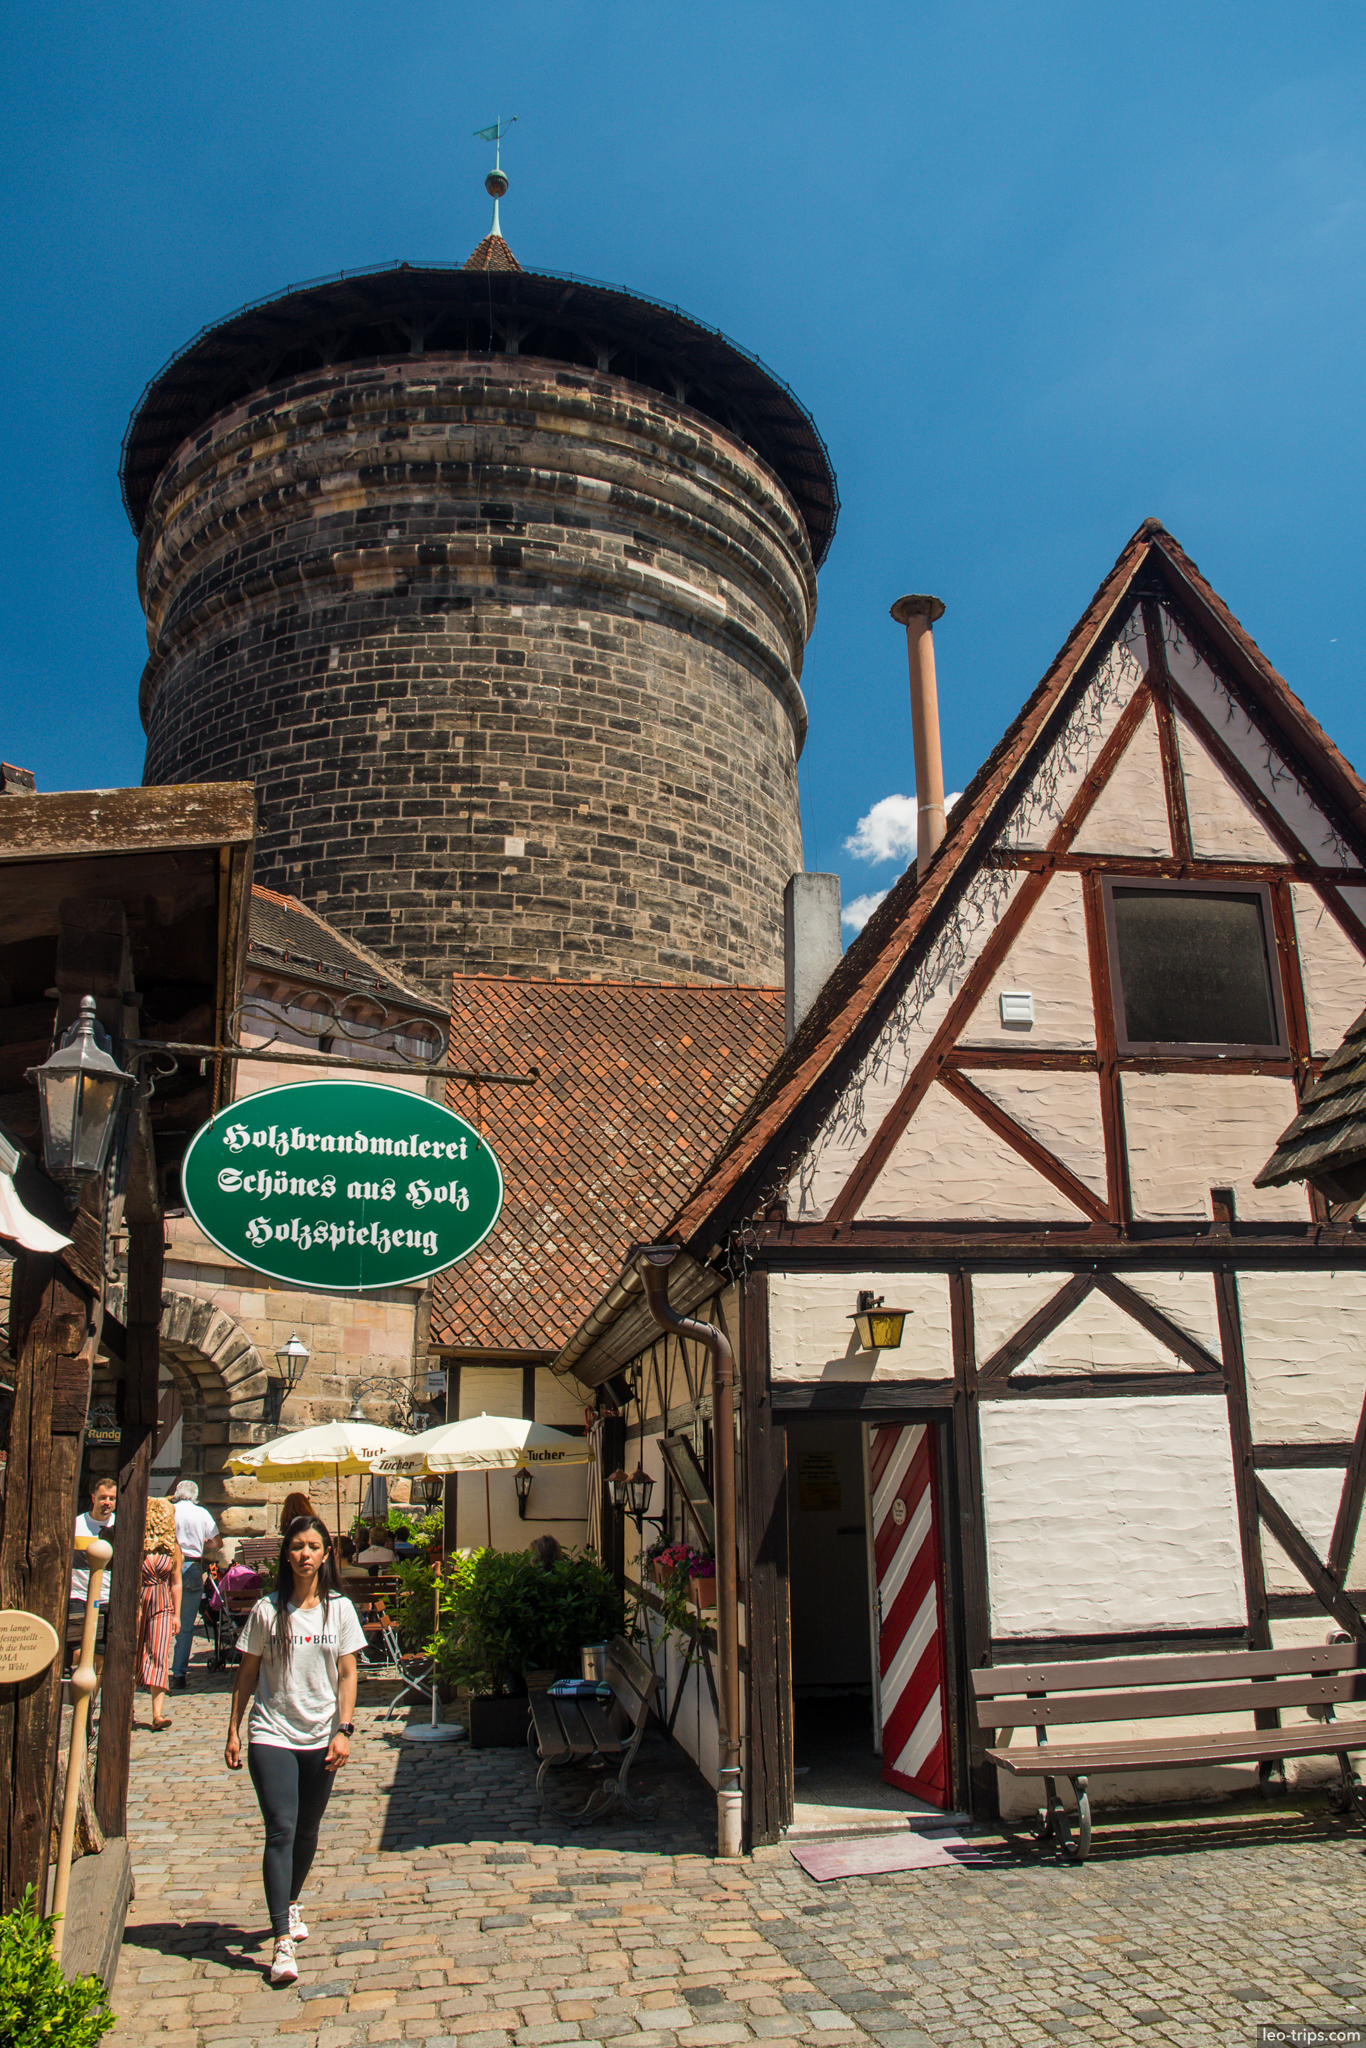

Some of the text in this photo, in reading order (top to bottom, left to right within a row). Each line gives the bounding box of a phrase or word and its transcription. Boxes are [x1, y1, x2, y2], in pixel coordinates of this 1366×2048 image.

[222, 1122, 468, 1161] Holzbrandmalerei
[217, 1167, 470, 1212] Schönes aus Holz
[245, 1215, 438, 1256] Holzspielzeug
[527, 1449, 565, 1461] Tucher
[378, 1458, 415, 1470] Tucher
[10, 1624, 30, 1633] lange
[0, 1633, 38, 1643] festgestellt
[19, 1643, 37, 1651] beste
[9, 1662, 29, 1671] Welt!
